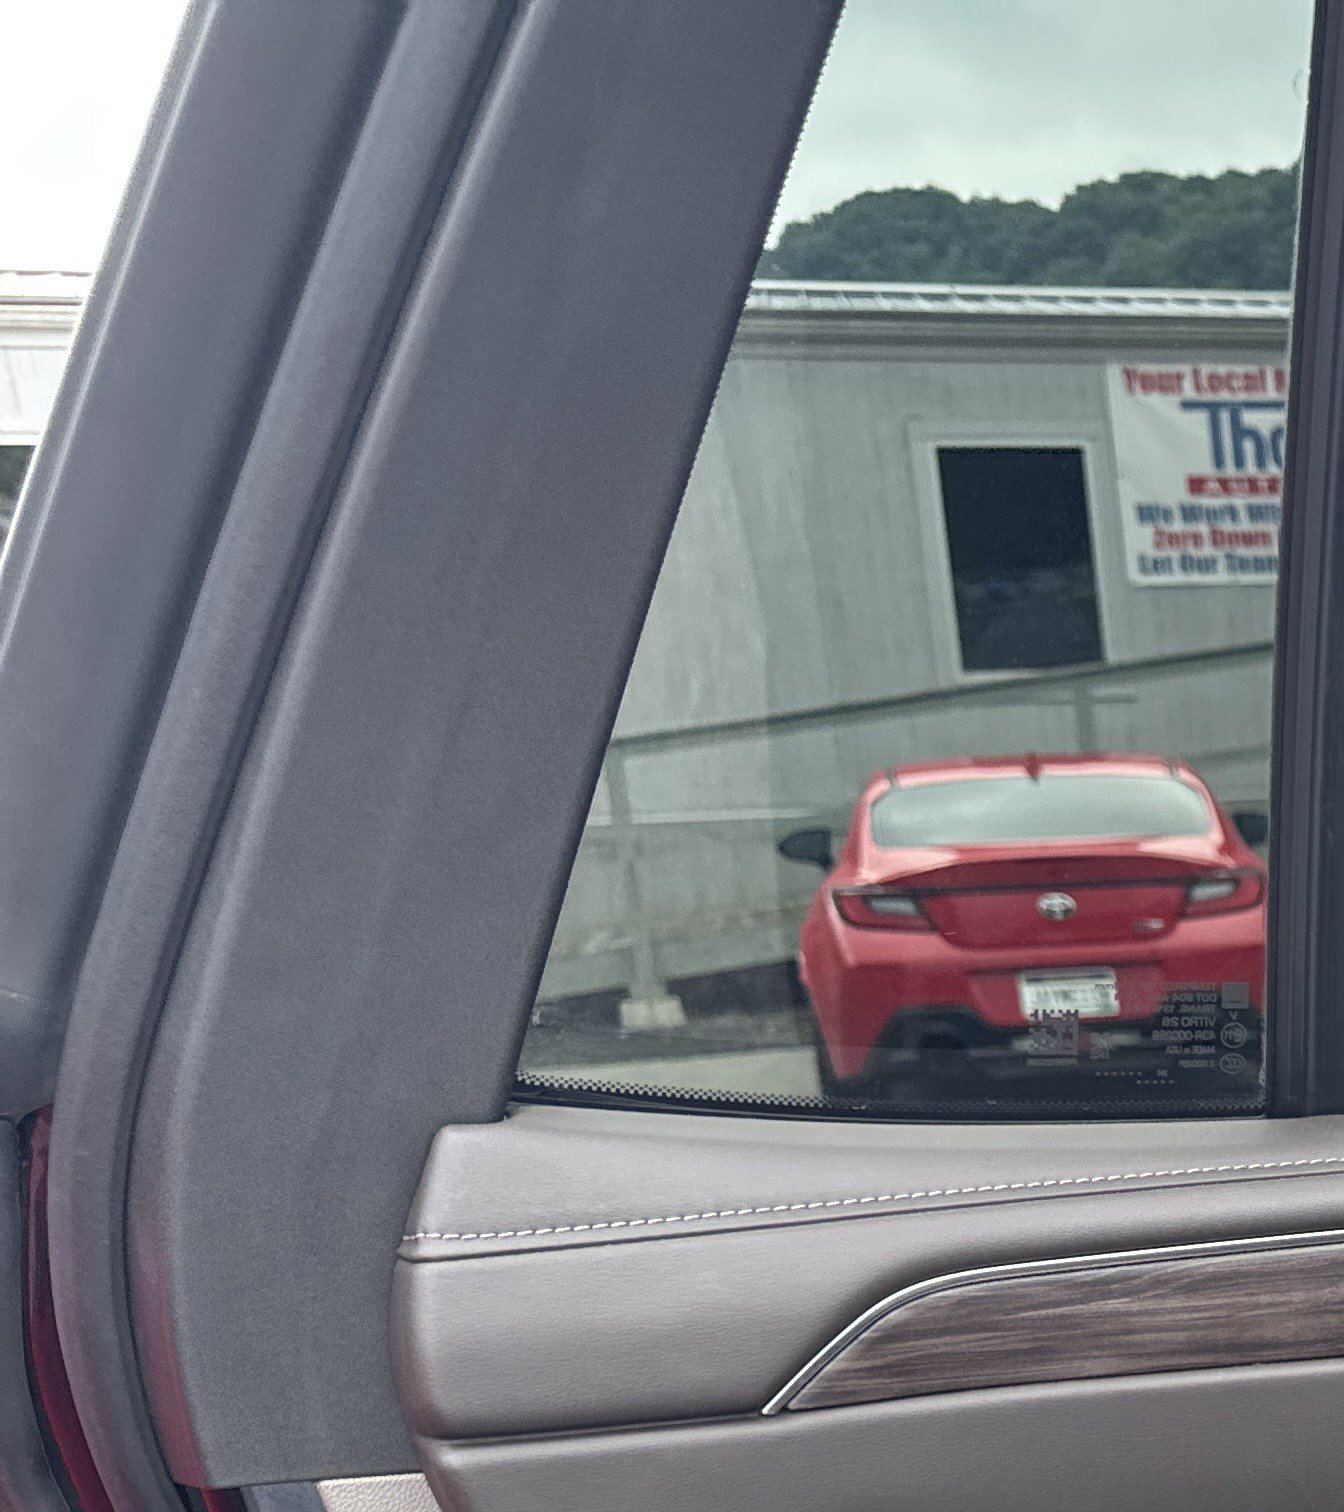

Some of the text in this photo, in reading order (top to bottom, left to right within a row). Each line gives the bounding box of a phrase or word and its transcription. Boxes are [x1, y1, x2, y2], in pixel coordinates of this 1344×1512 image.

[1124, 367, 1184, 395] Your
[1192, 368, 1266, 394] Local
[1211, 528, 1271, 548] Down
[1180, 554, 1217, 574] Our
